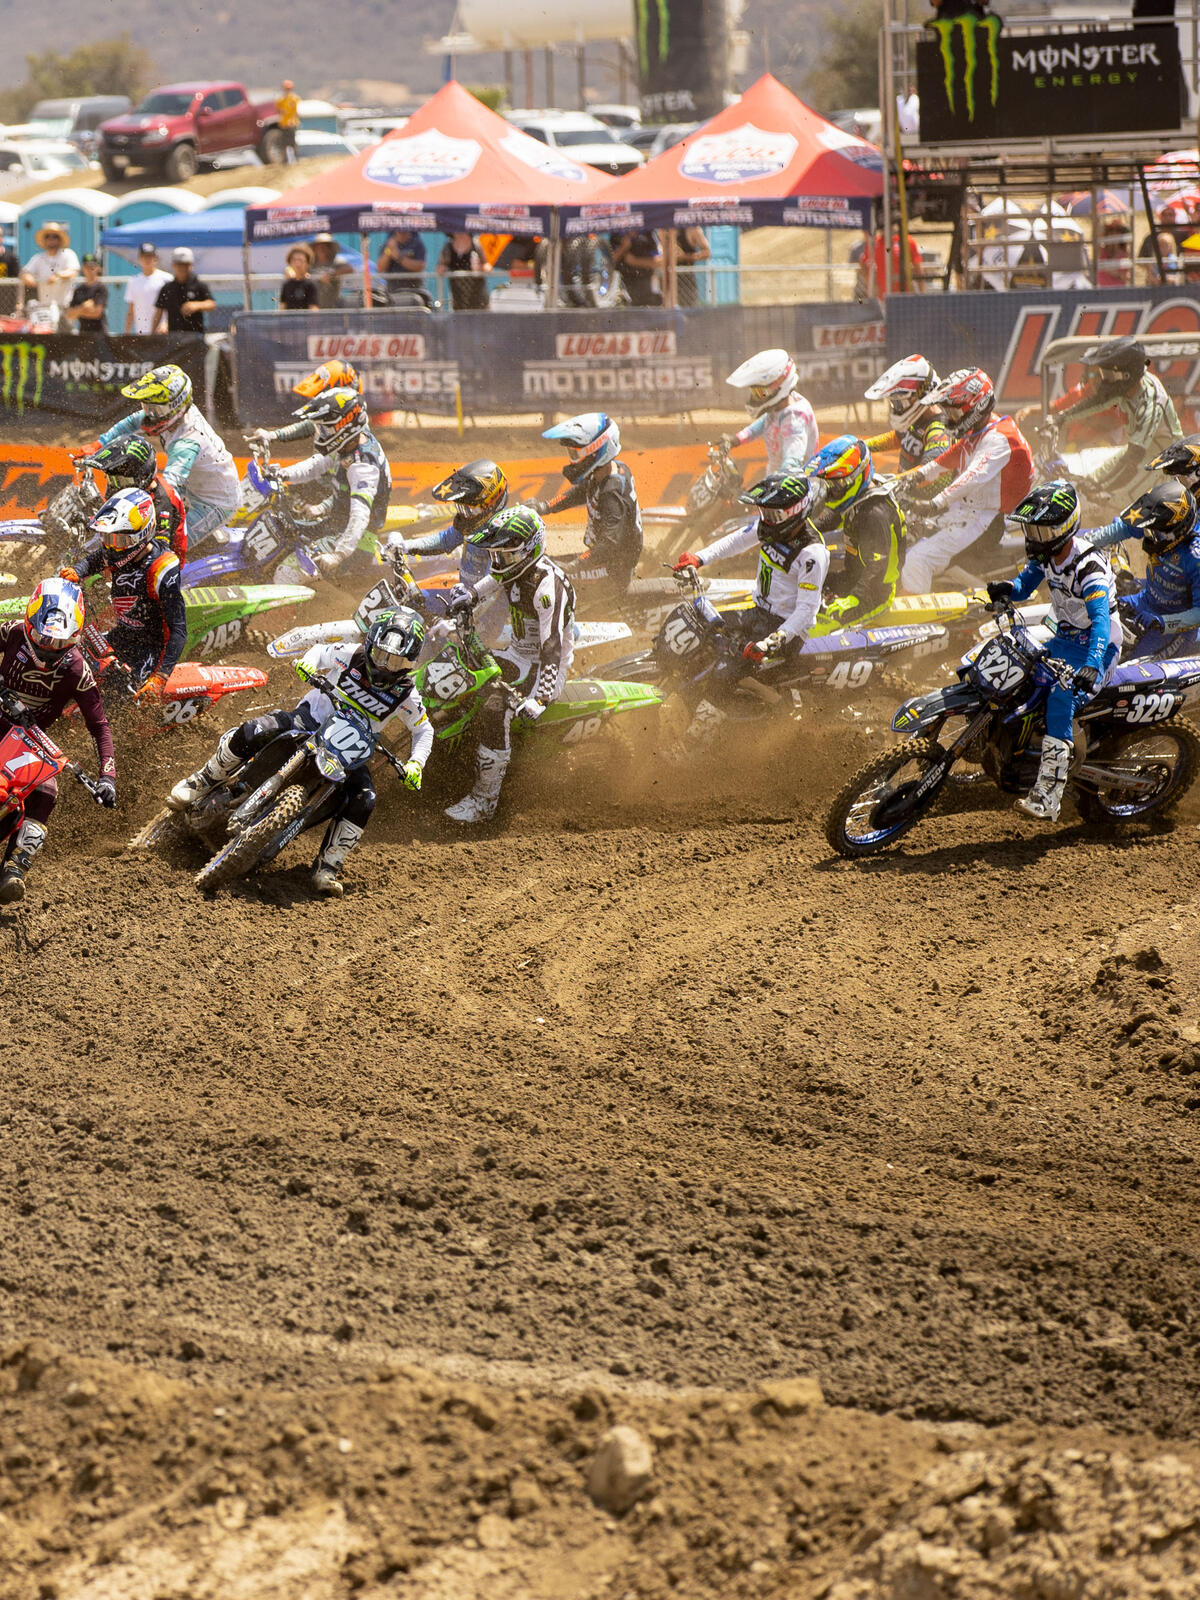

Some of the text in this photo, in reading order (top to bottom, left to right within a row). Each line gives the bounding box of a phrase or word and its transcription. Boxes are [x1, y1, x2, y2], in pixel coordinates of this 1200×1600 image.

[1012, 42, 1161, 75] MONSTER
[1034, 72, 1138, 88] ENERGY
[314, 334, 419, 358] LUCAS OIL
[562, 331, 671, 356] LUCAS OIL
[274, 369, 460, 393] MCROSS
[523, 367, 712, 392] MOTOCROSS
[200, 619, 242, 657] 243
[664, 617, 701, 656] 49
[890, 636, 929, 653] DUNLOP
[426, 662, 468, 700] 48
[825, 660, 873, 690] 49
[978, 647, 1026, 691] 329
[175, 685, 207, 695] HONDA
[340, 675, 390, 716] THOR
[162, 700, 199, 724] 96
[1125, 693, 1176, 724] 329
[323, 716, 372, 763] 102
[562, 718, 601, 743] 48
[5, 750, 42, 773] 1
[916, 762, 946, 798] DUNLOP
[278, 818, 305, 849] DUNLOP
